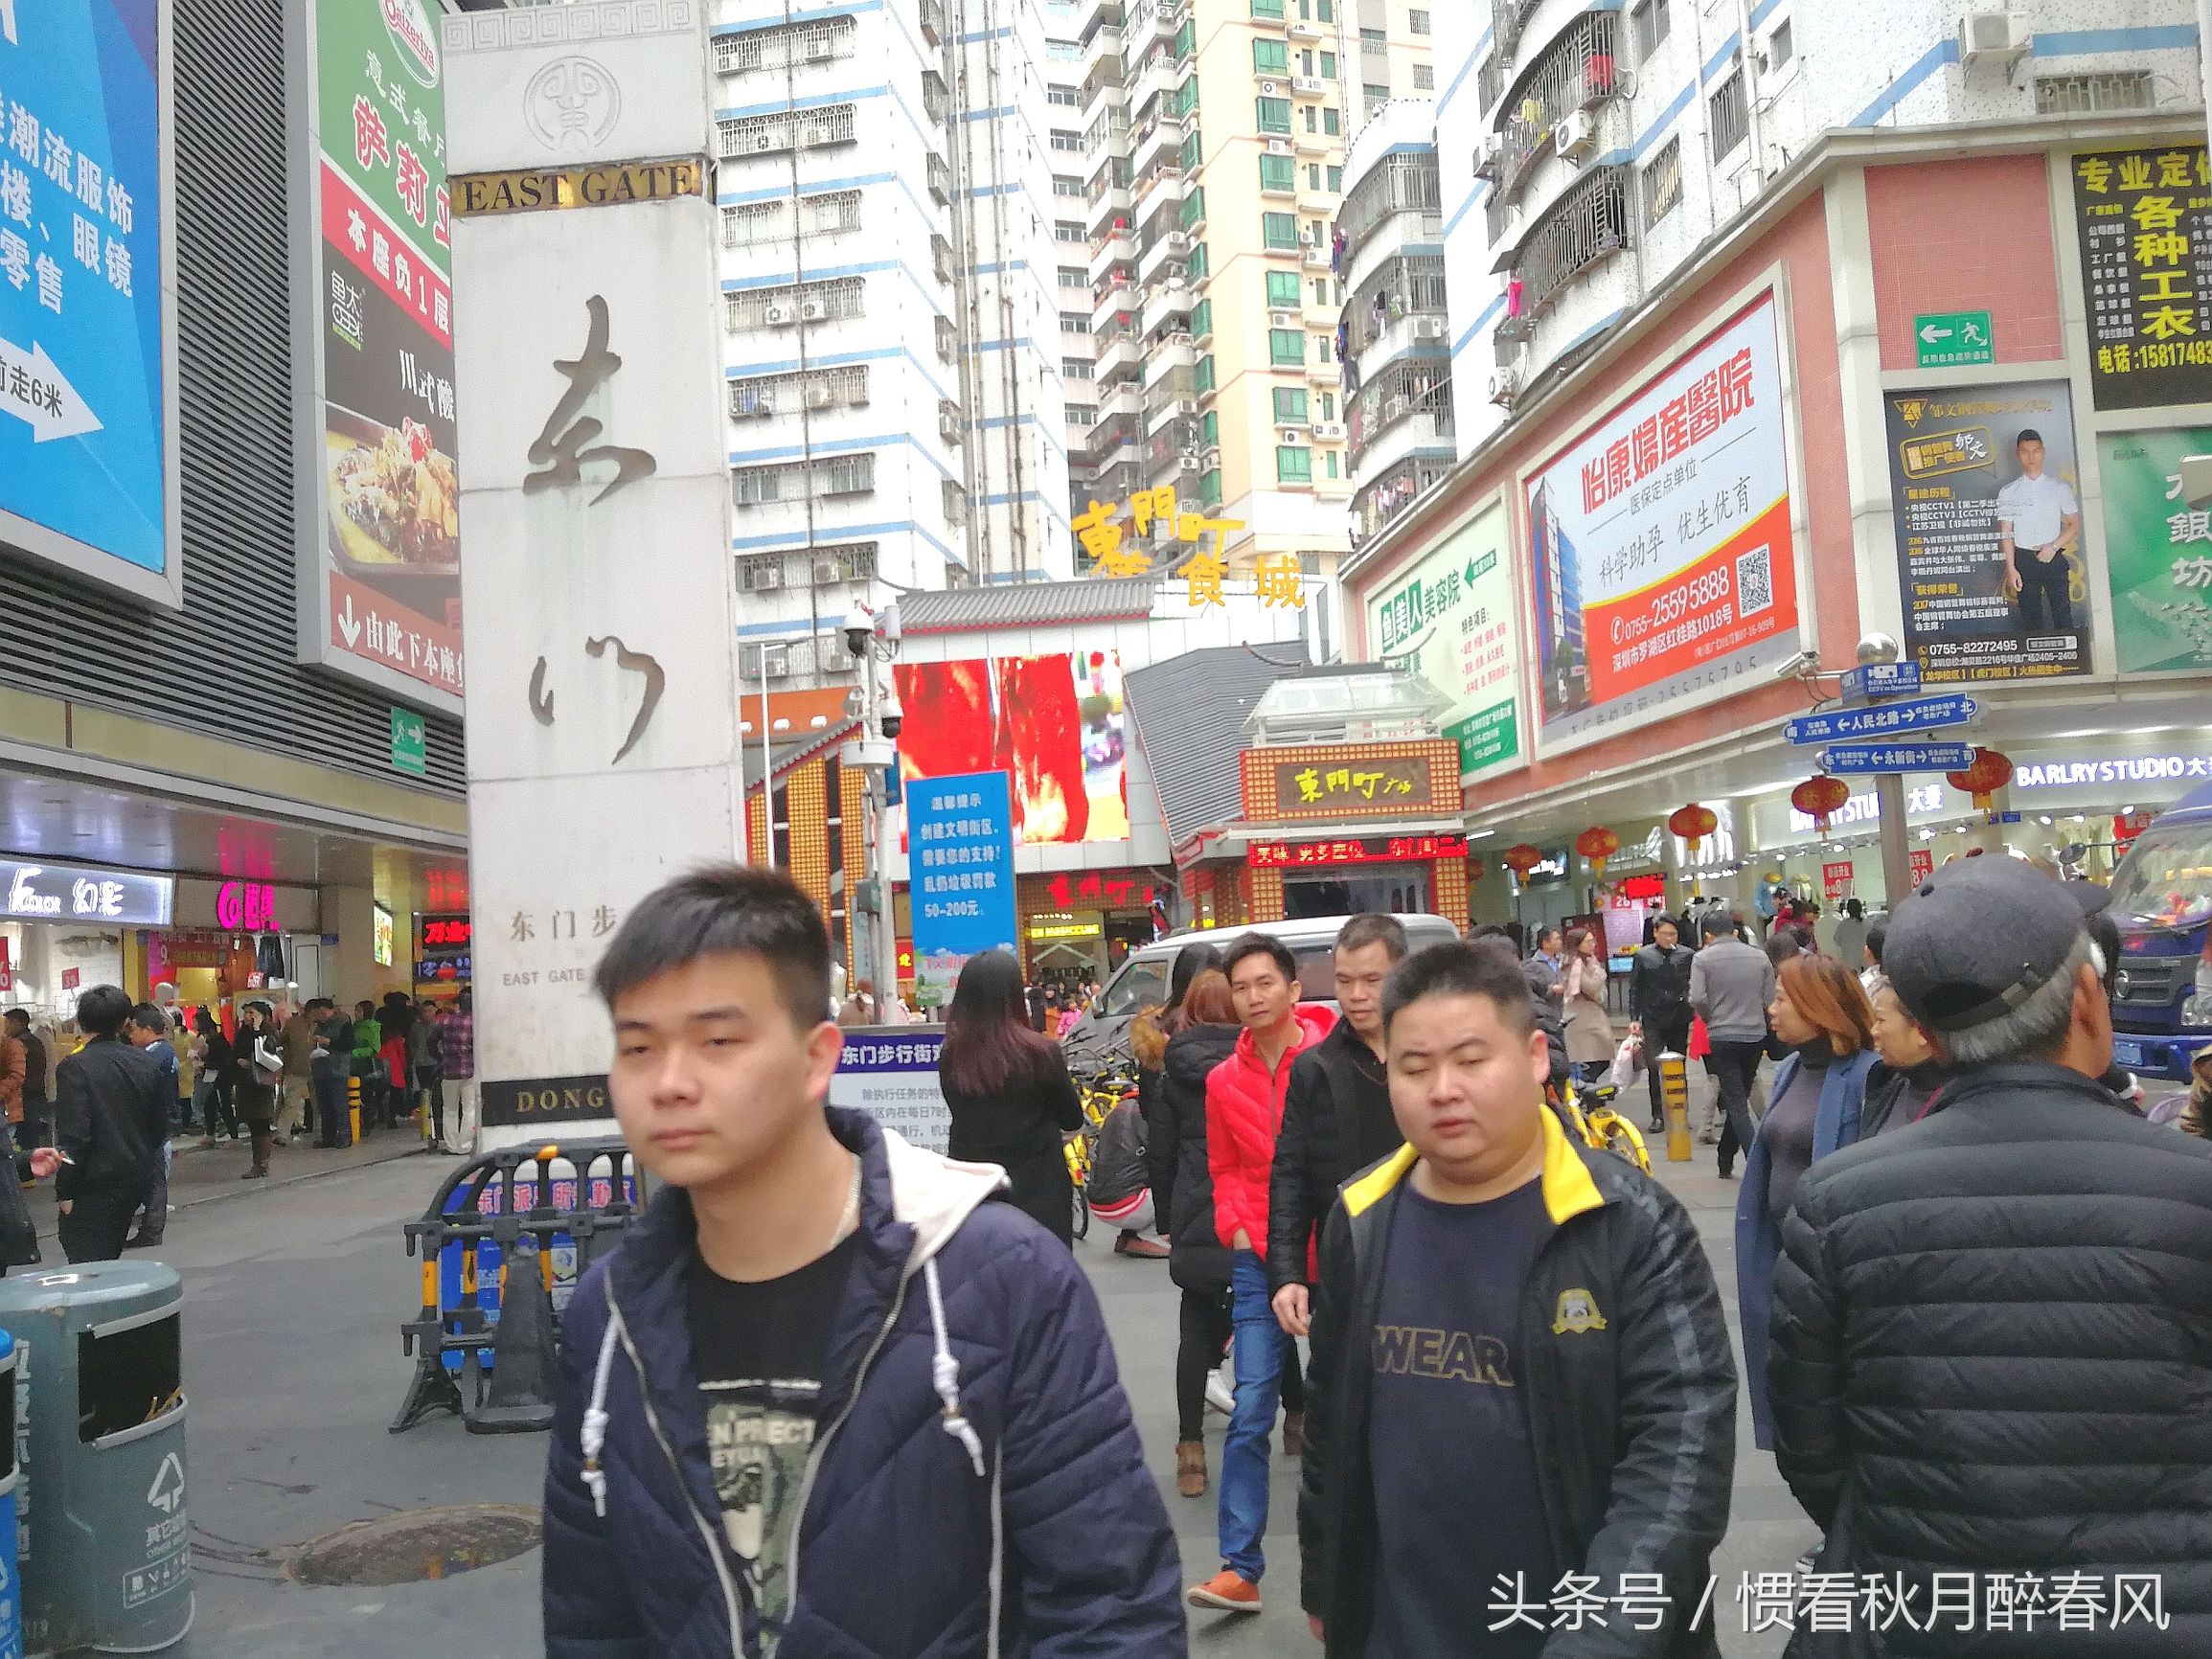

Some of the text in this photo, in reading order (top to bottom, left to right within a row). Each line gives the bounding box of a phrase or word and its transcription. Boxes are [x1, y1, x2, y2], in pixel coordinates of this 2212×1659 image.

[0, 94, 133, 236] 潮流服饰
[463, 163, 694, 214] EAST GATE
[2131, 196, 2197, 340] 各种工衣
[1630, 458, 1697, 515] 医保定点单位
[1599, 476, 1750, 588] 科学助孕 优生优育
[1929, 640, 2018, 655] 0755-82272495
[1851, 712, 1900, 731] 人民北路
[1884, 751, 1916, 765] 永新街
[2101, 756, 2184, 782] STUDIO
[511, 905, 617, 943] 东门步
[503, 968, 585, 987] EAST GATE
[517, 1087, 605, 1114] DONG
[1373, 1325, 1515, 1387] WEAR
